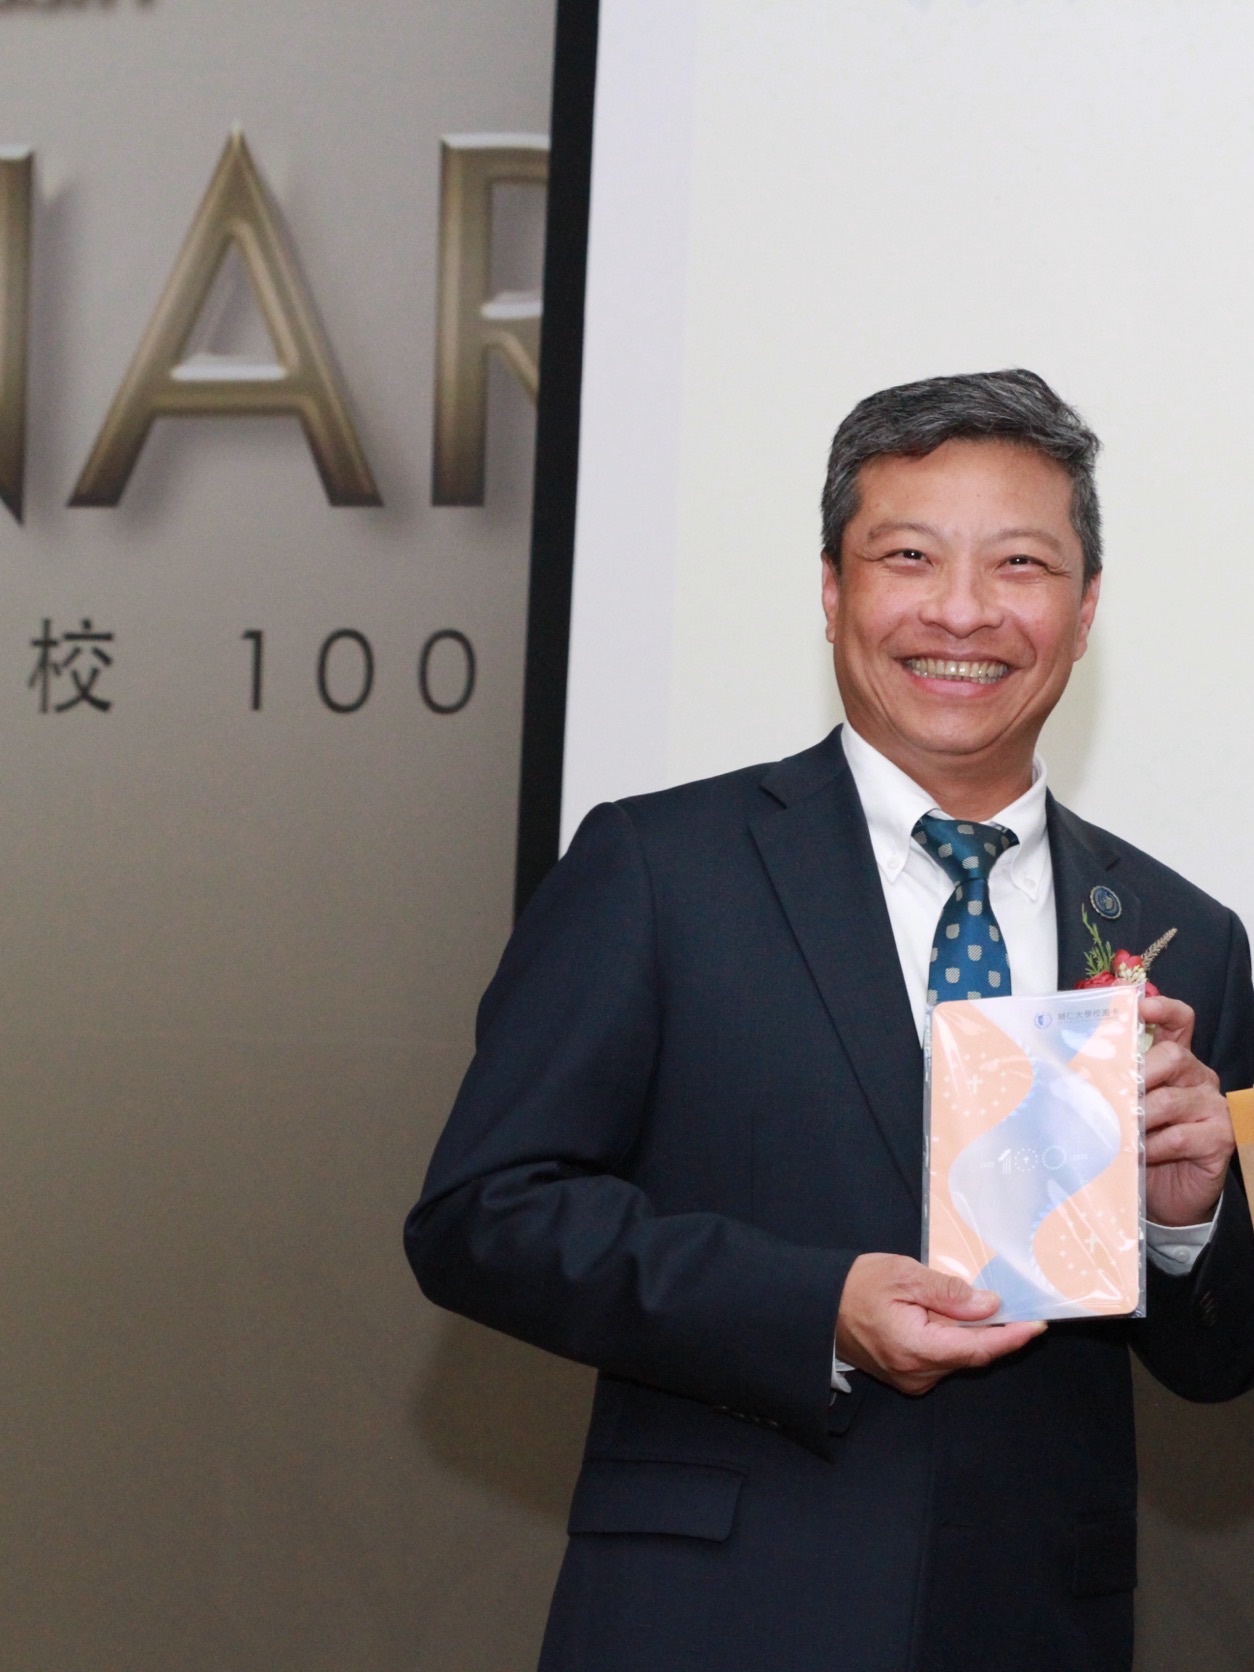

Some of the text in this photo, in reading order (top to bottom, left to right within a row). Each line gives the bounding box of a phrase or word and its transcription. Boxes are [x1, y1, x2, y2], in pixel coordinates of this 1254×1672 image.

[0, 119, 550, 526] AR
[27, 618, 478, 716] 校 100
